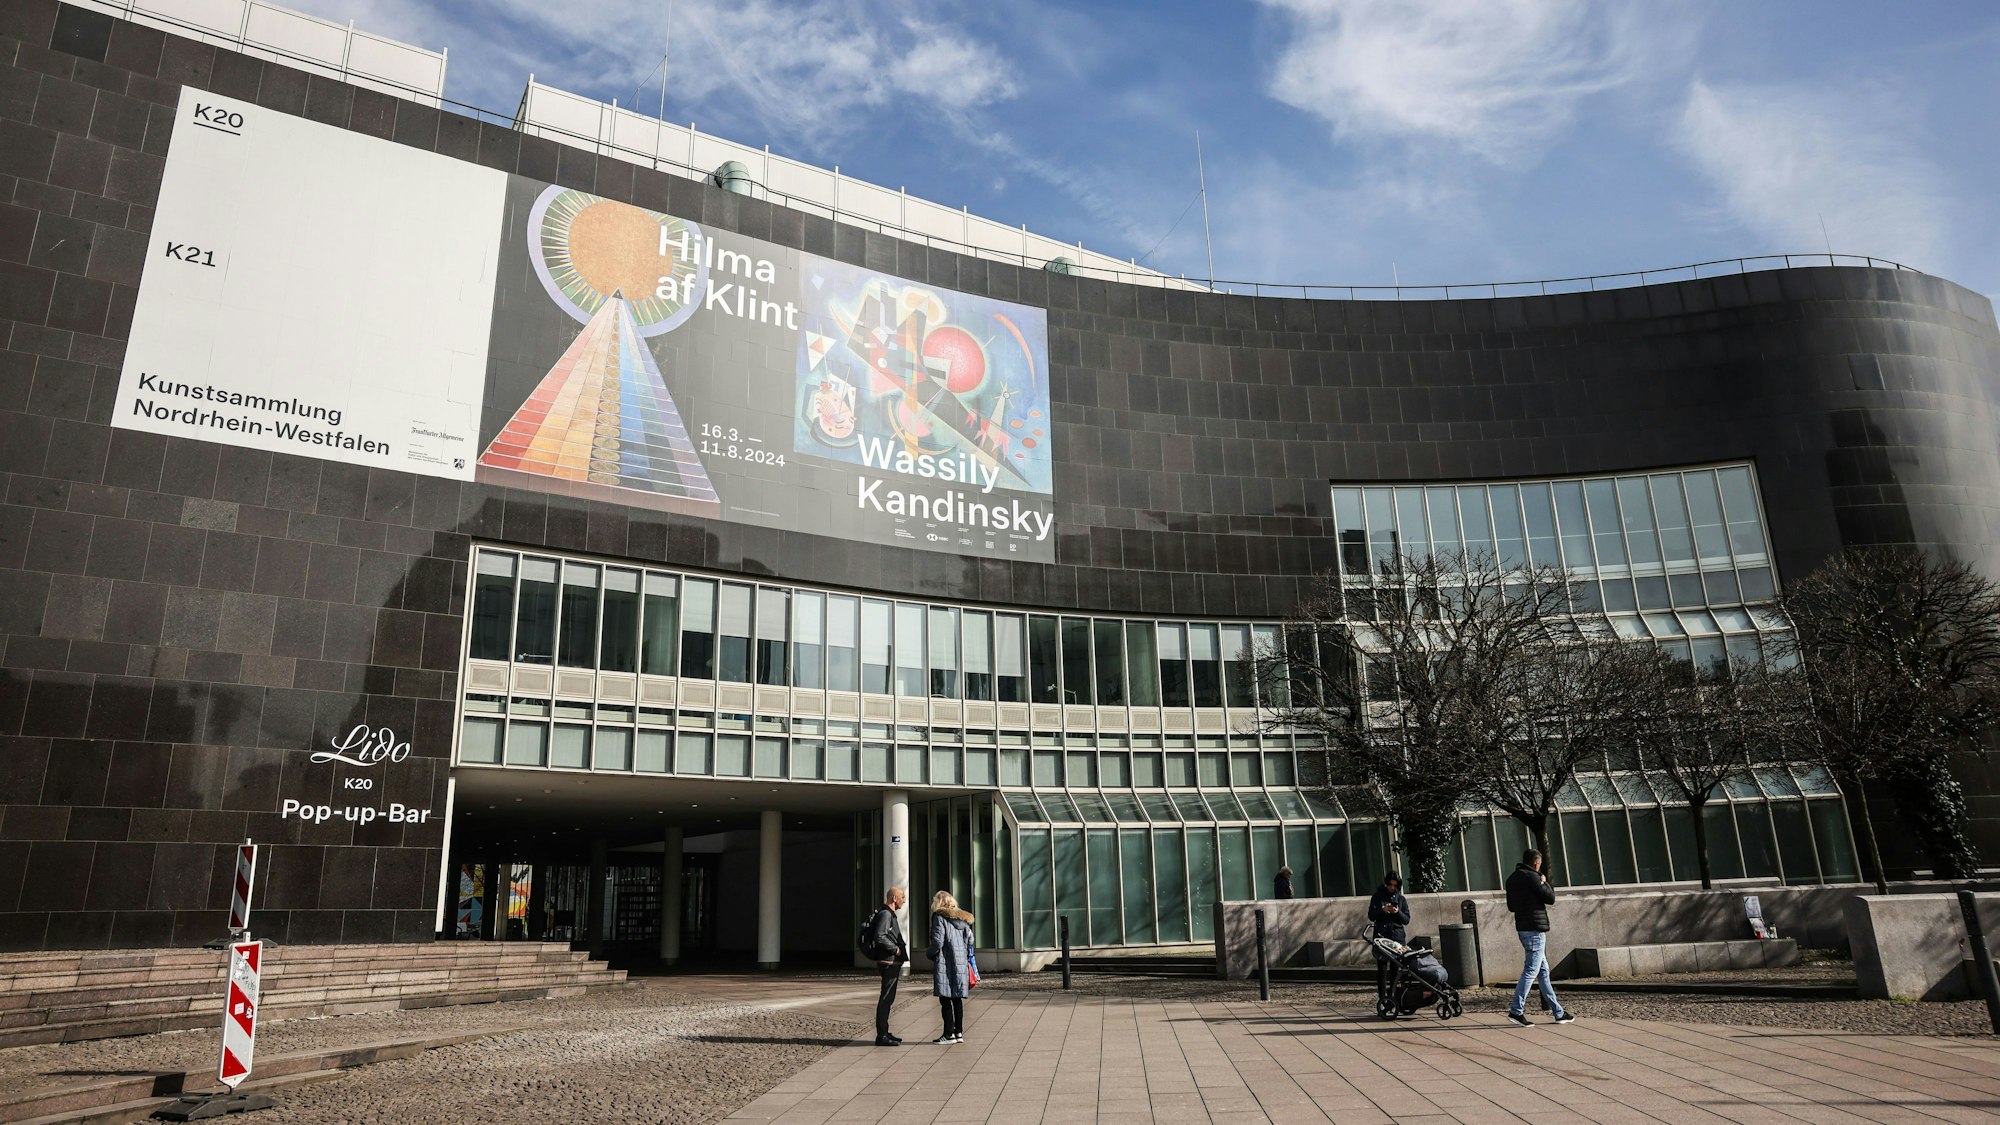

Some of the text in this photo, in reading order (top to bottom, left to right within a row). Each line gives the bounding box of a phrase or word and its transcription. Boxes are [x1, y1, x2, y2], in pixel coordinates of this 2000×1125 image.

[194, 103, 244, 129] K20
[165, 241, 217, 268] K21
[659, 225, 776, 284] Hilma
[655, 273, 799, 331] af Klint
[138, 371, 343, 426] Kunstsammlung
[133, 397, 391, 456] Nordrhein-Westfalen
[700, 440, 786, 468] 11.8.2024
[857, 433, 1000, 494] Wassily
[858, 476, 1054, 541] Kandinsky
[310, 724, 411, 767] Lido
[344, 777, 373, 790] K20
[281, 799, 431, 826] Pop-up-Bar
